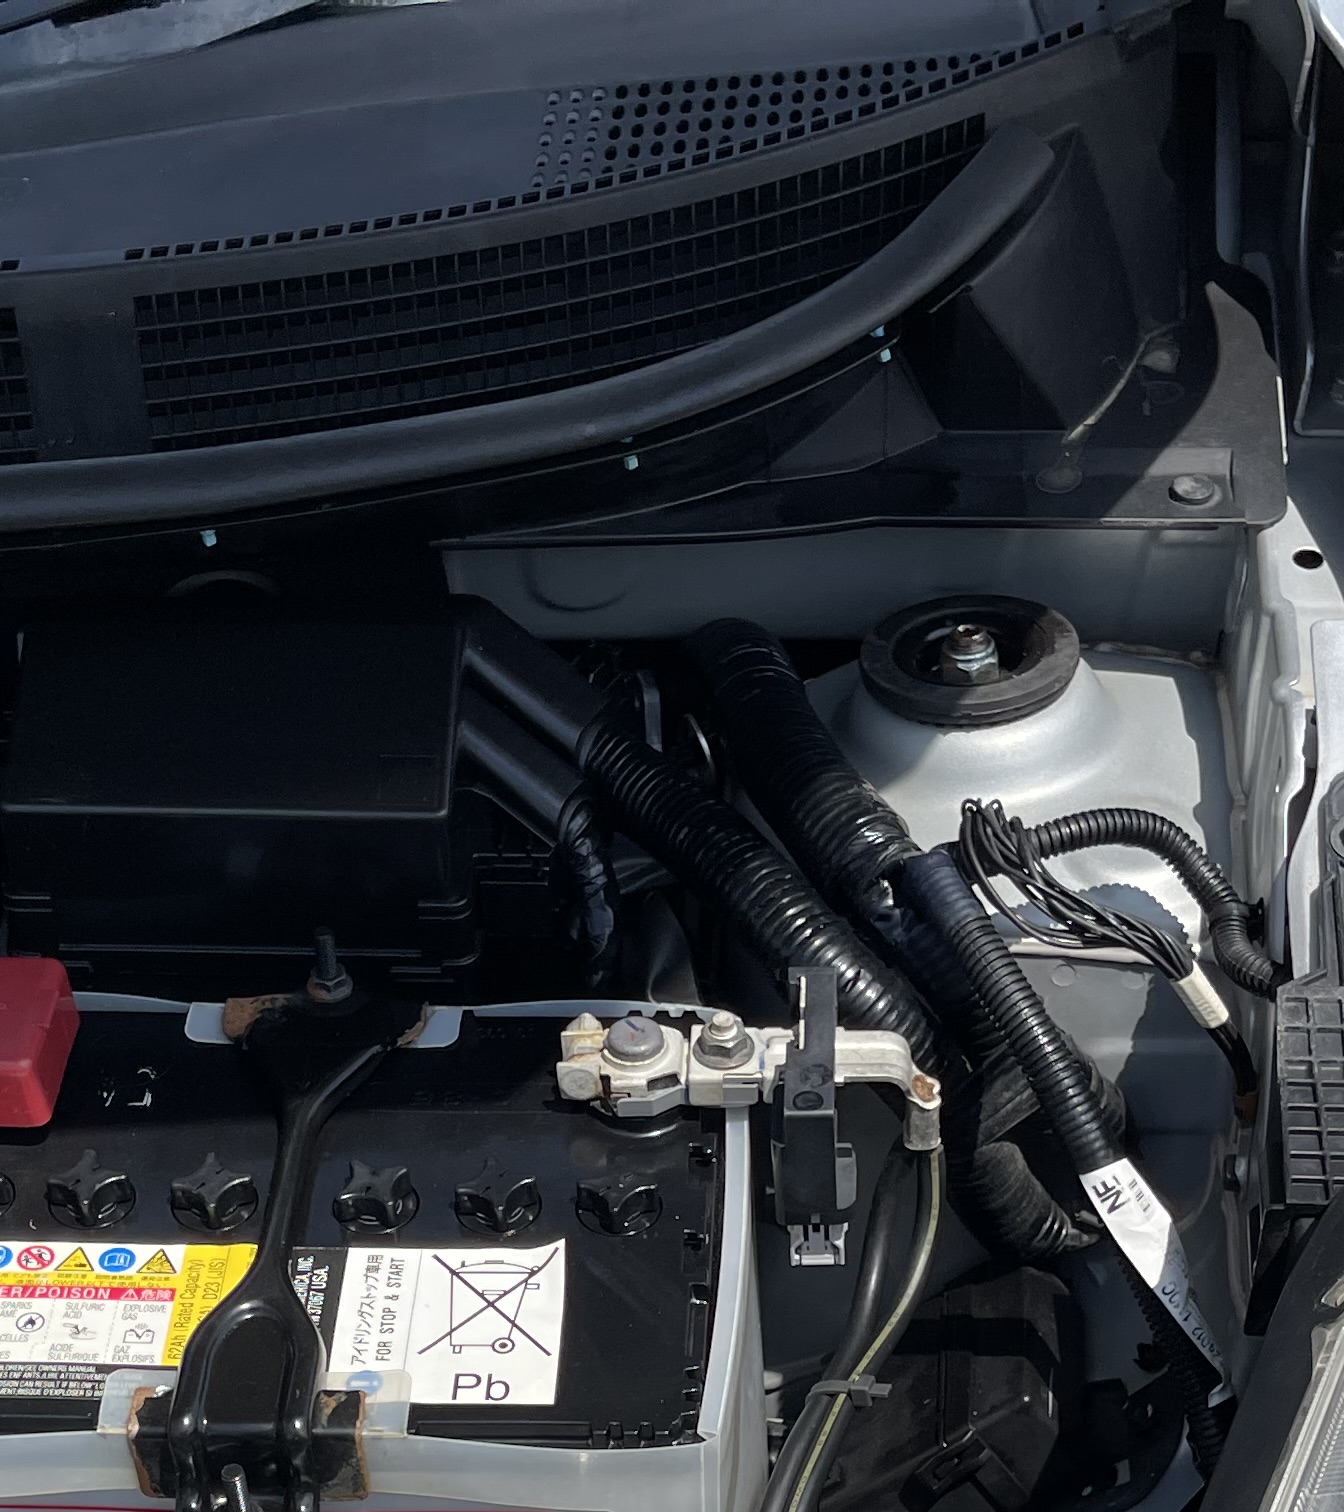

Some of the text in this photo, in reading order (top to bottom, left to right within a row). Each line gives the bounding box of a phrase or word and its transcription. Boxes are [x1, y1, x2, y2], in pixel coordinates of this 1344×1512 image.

[386, 1257, 405, 1289] START
[0, 1301, 33, 1309] SPARKS
[63, 1311, 82, 1319] ACID
[123, 1304, 167, 1313] EXPLOSIVE
[350, 1255, 384, 1366] アイドリングストップ車用
[379, 1307, 397, 1334] STOP
[375, 1340, 393, 1361] FOR
[452, 1373, 510, 1401] Pb
